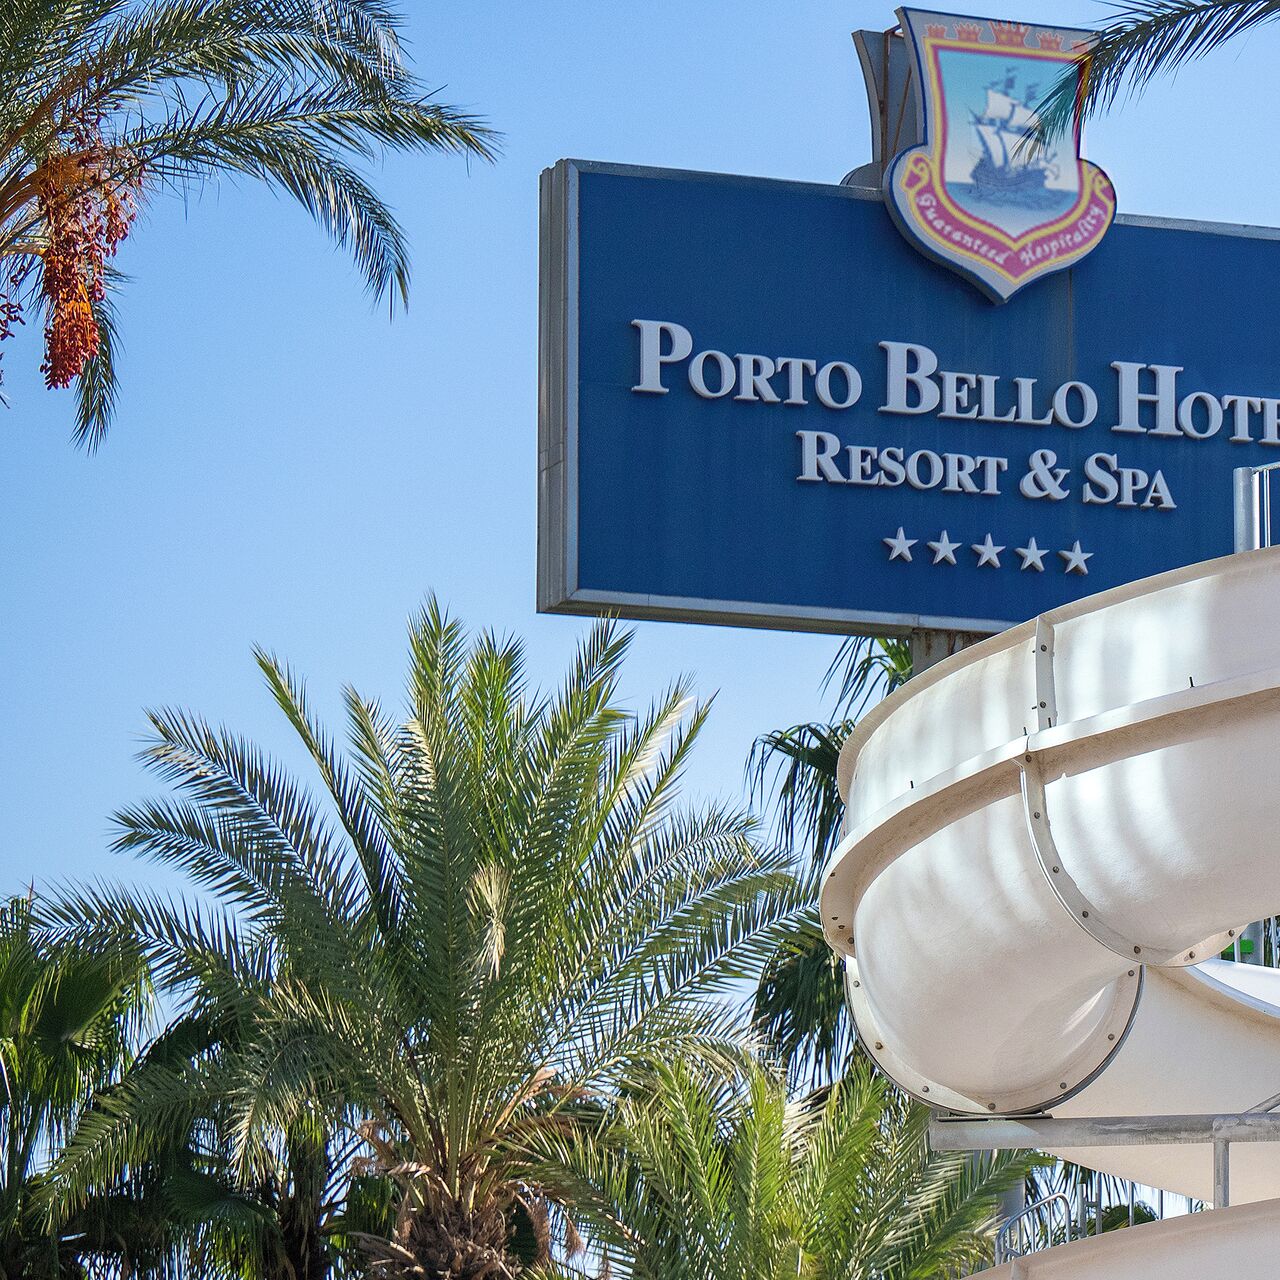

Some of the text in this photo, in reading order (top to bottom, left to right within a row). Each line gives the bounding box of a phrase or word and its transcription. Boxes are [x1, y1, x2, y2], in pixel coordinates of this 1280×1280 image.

[917, 193, 1106, 267] Guaranteed Hospitality
[630, 318, 863, 410] PORTO
[878, 340, 1098, 429] BELLO
[797, 430, 1178, 511] RESORT & SPA
